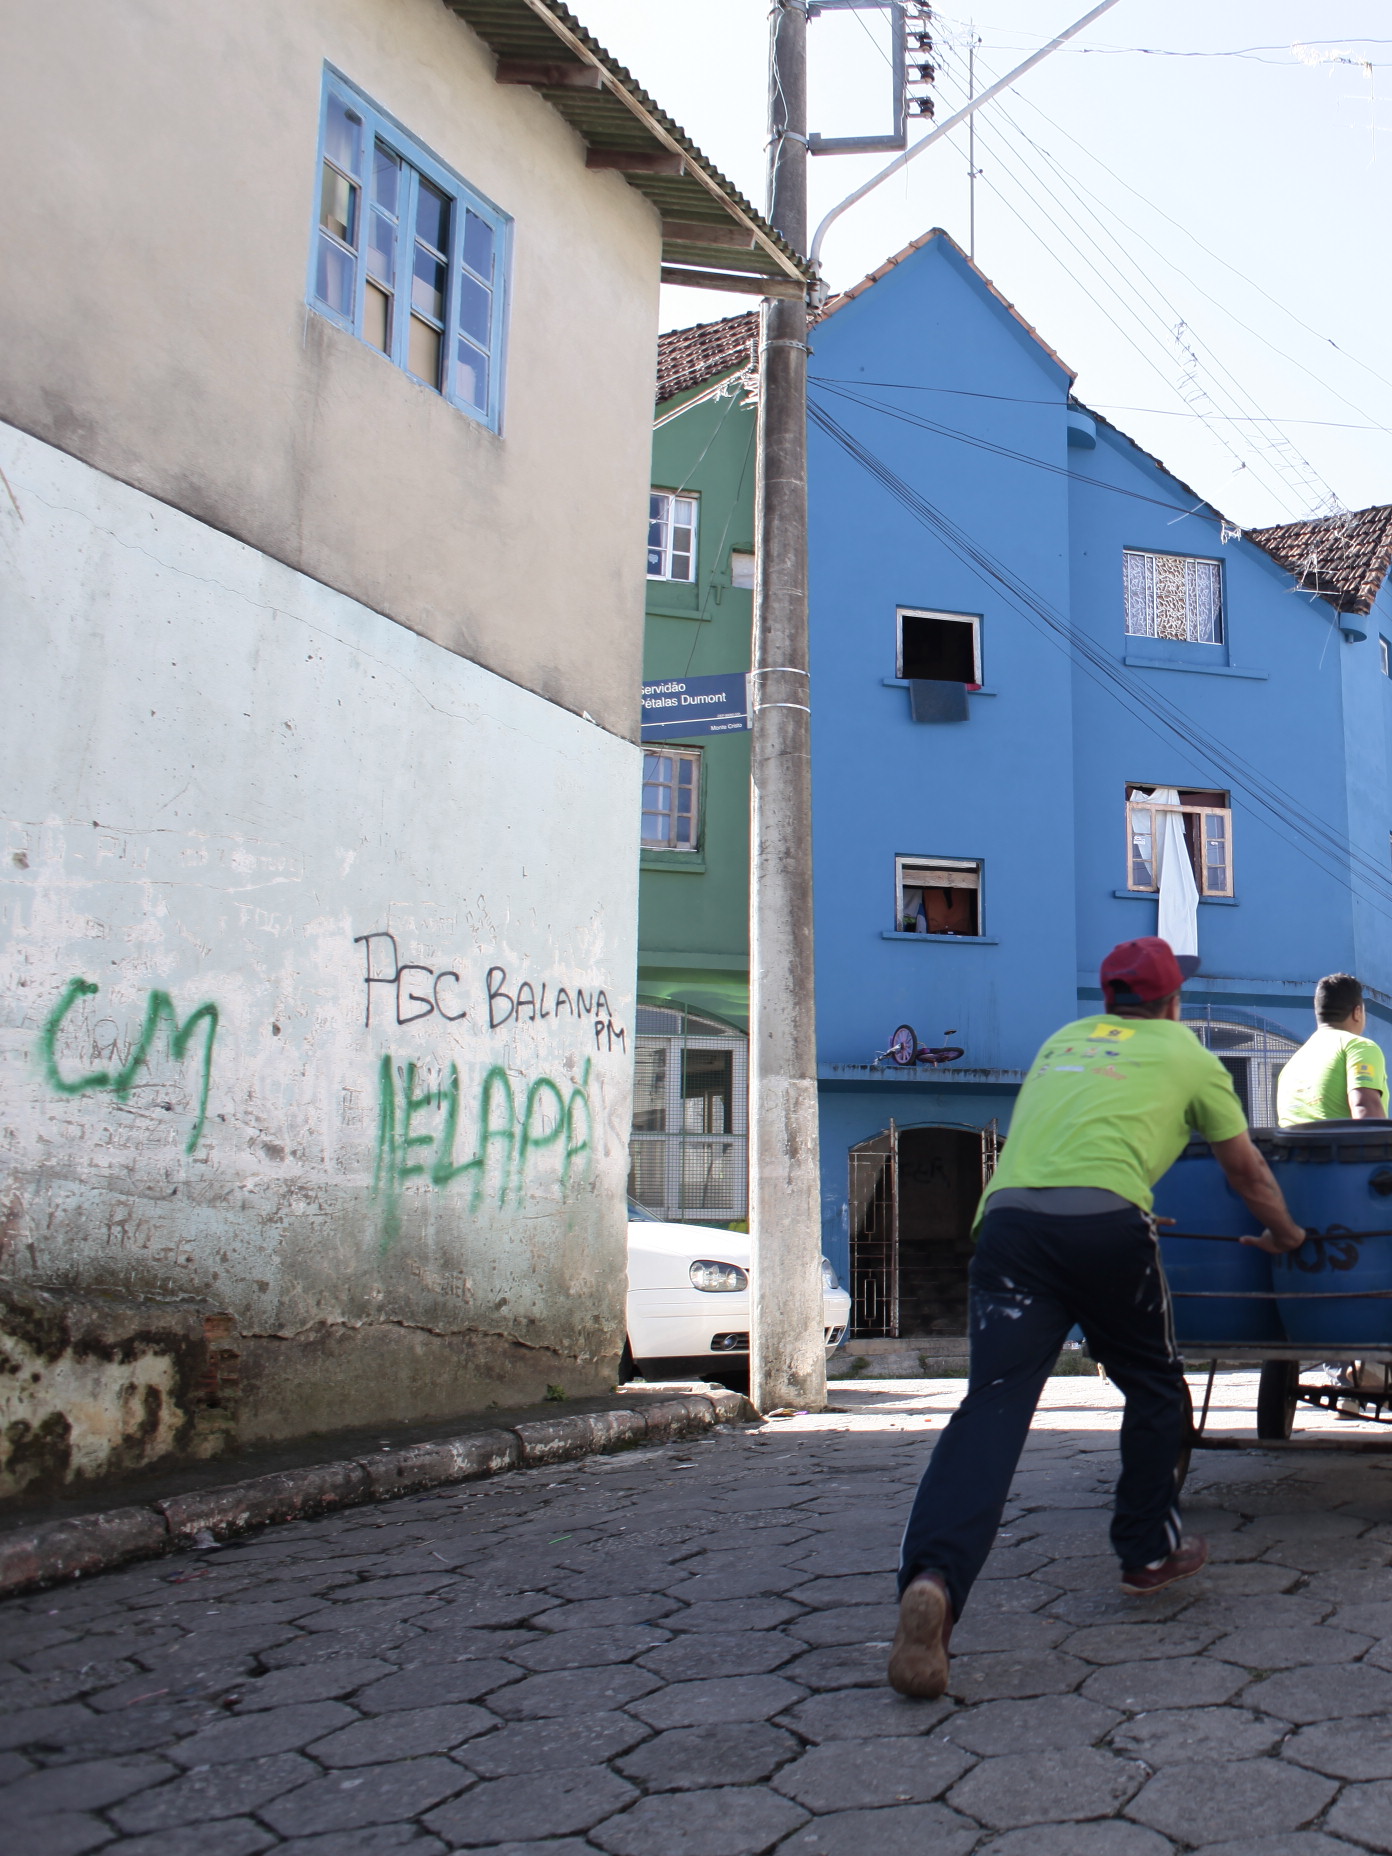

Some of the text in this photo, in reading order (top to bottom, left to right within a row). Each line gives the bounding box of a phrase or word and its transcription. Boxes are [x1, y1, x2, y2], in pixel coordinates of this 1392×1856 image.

[681, 692, 726, 706] Dumont
[354, 932, 612, 1029] PGC BALANA
[595, 1018, 626, 1055] PM
